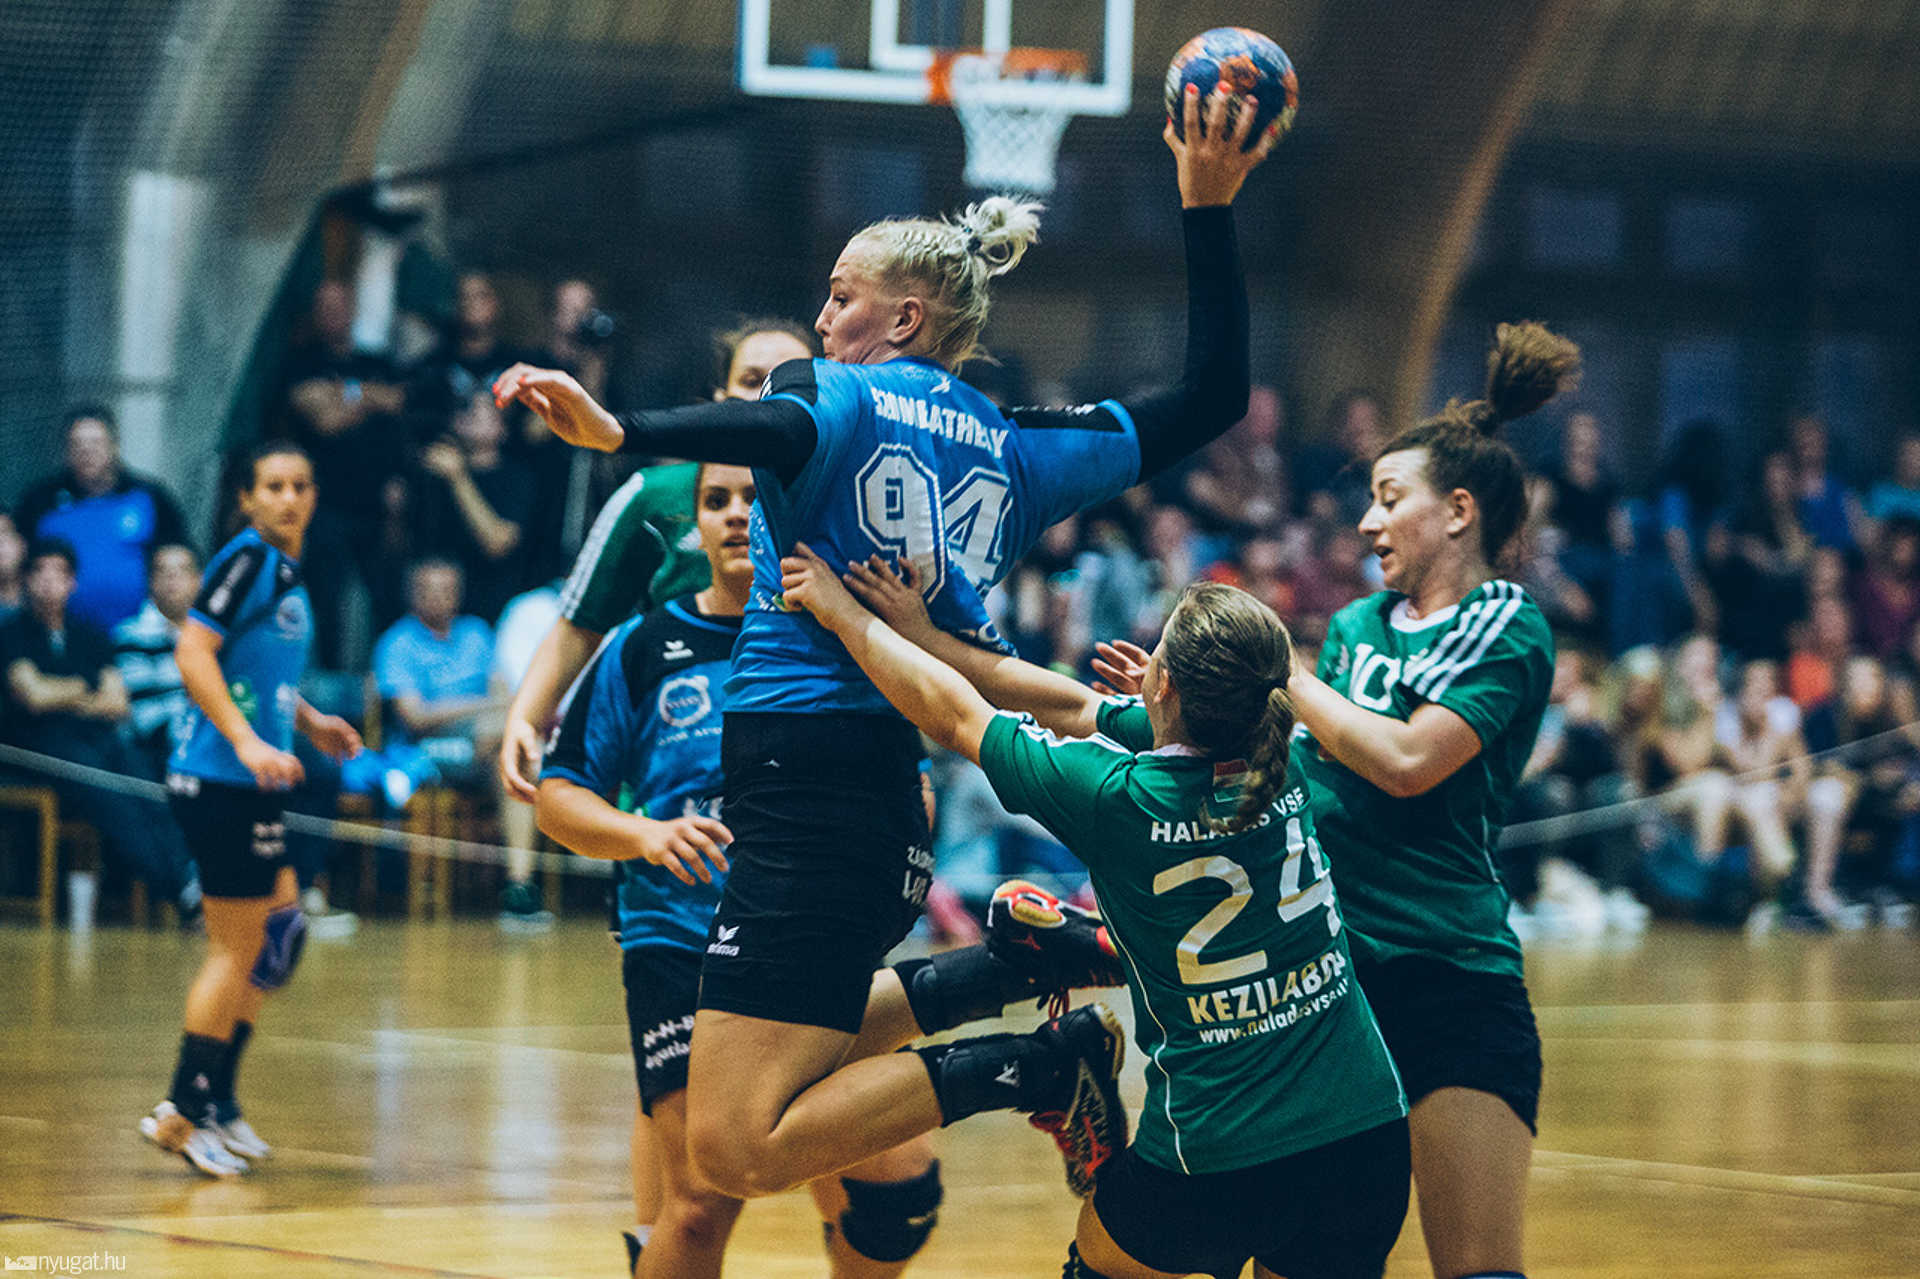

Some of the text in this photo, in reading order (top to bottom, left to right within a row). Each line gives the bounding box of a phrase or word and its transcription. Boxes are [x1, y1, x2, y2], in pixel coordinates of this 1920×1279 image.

[855, 442, 1014, 604] 94
[1348, 643, 1401, 711] 10
[1272, 787, 1305, 816] VSE
[1153, 817, 1342, 985] 24
